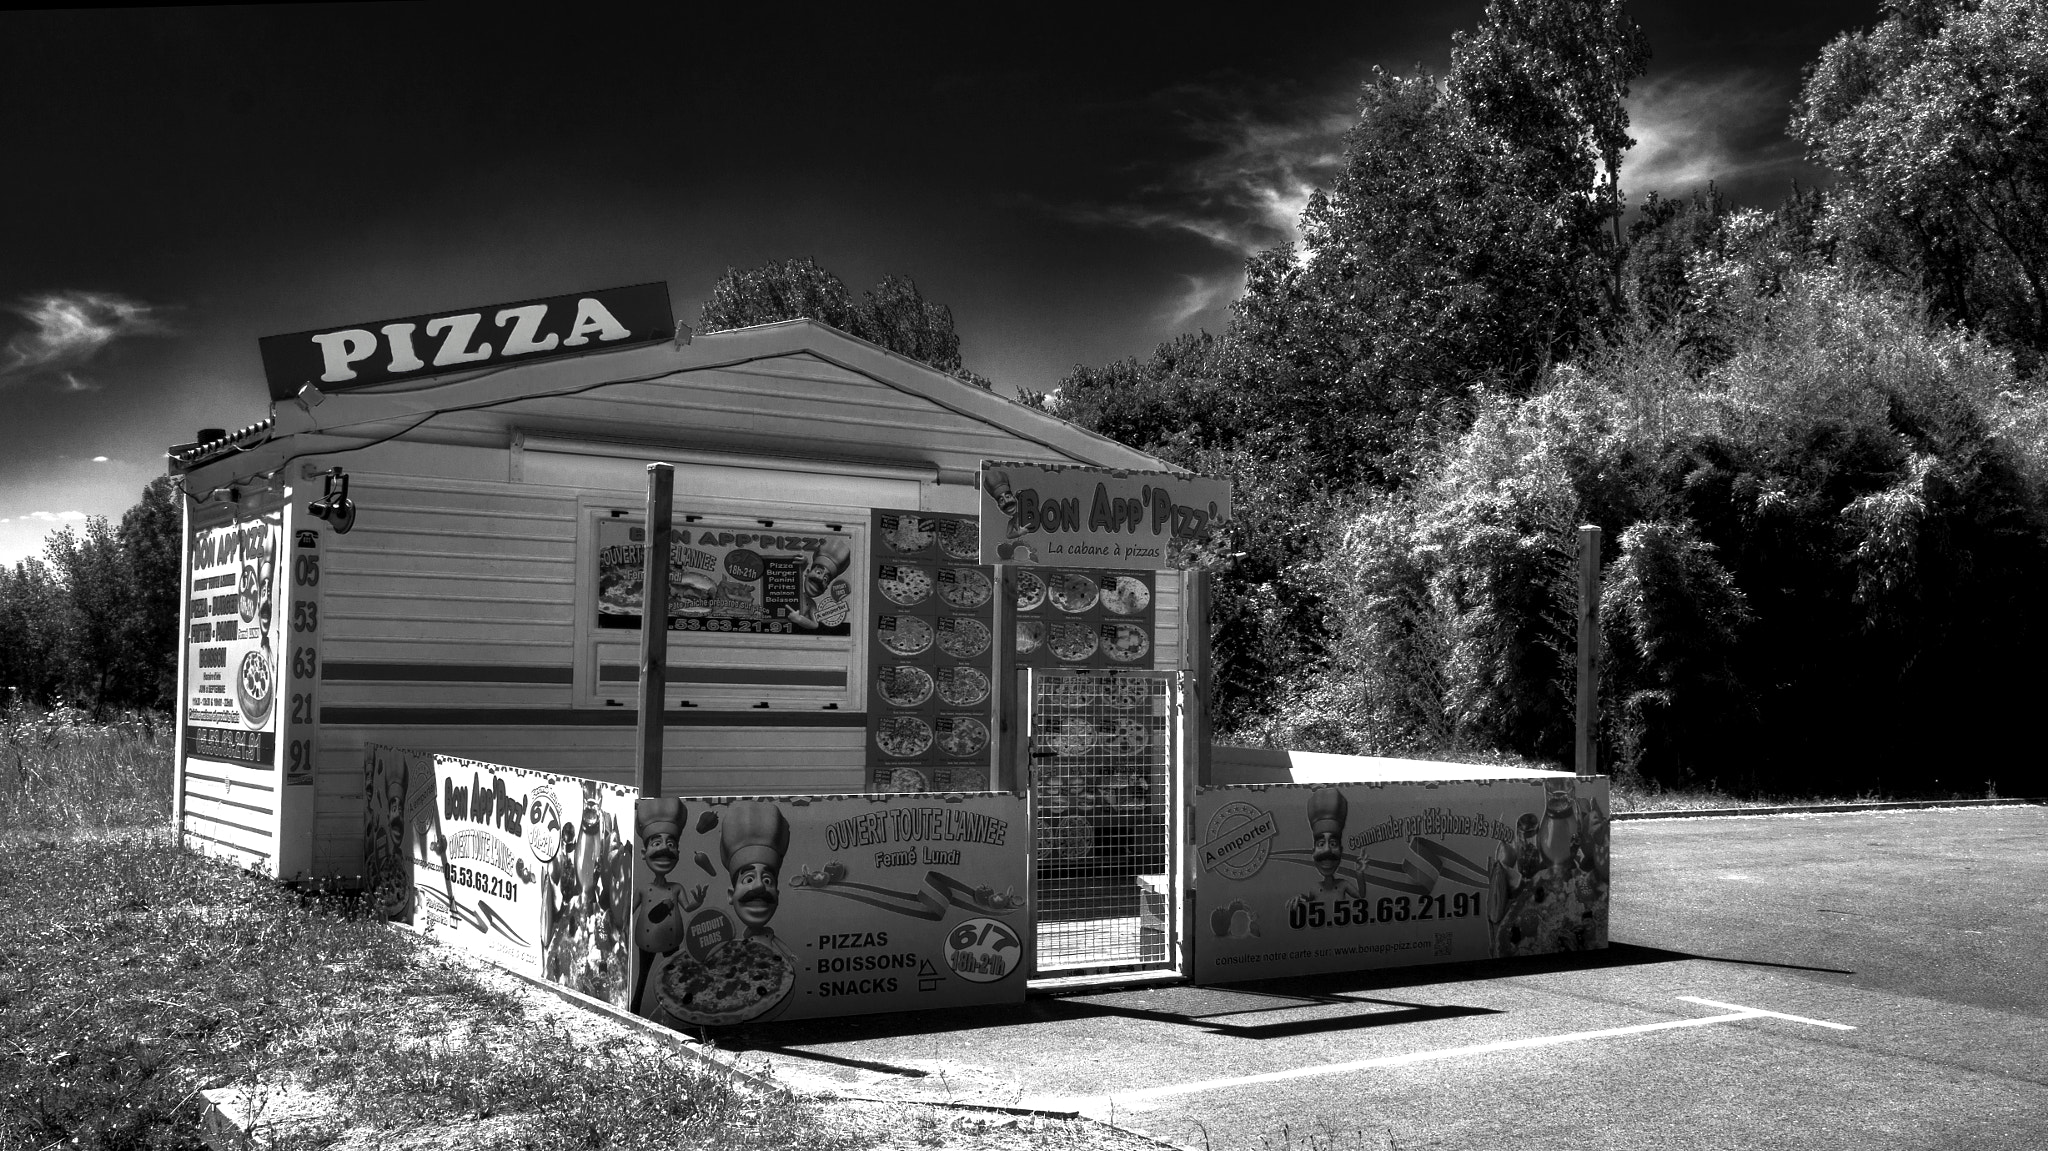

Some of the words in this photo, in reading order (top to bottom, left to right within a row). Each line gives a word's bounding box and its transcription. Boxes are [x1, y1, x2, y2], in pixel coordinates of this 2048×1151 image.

[312, 298, 632, 382] PIZZA
[1017, 488, 1079, 534] BON
[629, 527, 691, 545] BN
[1048, 542, 1058, 554] La
[1068, 543, 1108, 556] cabane
[1113, 544, 1120, 556] à
[1124, 545, 1160, 560] pizzas
[295, 554, 319, 586] 05
[728, 564, 758, 580] 18h-21h
[766, 570, 797, 578] Burger
[294, 601, 317, 632] 53
[292, 647, 316, 679] 63
[291, 694, 313, 725] 21
[290, 740, 311, 772] 91
[444, 776, 468, 821] BON
[529, 800, 560, 831] 6/7
[825, 810, 887, 851] OUVERT
[889, 807, 943, 841] TOUTE
[944, 809, 1008, 846] L'ANNEE
[1404, 814, 1422, 843] par
[1422, 807, 1471, 841] téléphone
[875, 846, 917, 868] Fermé
[922, 846, 960, 865] Lundi
[1206, 851, 1216, 864] A
[1217, 821, 1270, 856] emporter
[444, 862, 517, 902] 05.53.63.21.91
[690, 915, 724, 937] PRODUIT
[1289, 892, 1481, 930] 05.53.63.21.91
[699, 931, 722, 948] FRAIS
[819, 932, 888, 949] PIZZAS
[949, 923, 1019, 953] 6/7
[1215, 953, 1261, 966] consultez
[1263, 951, 1288, 961] notre
[1289, 950, 1312, 960] carte
[1334, 940, 1432, 956] www.bonapp-pizz.com
[818, 953, 917, 973] BOISSONS
[950, 949, 1006, 976] 18h-21h
[819, 977, 898, 997] SNACKS
